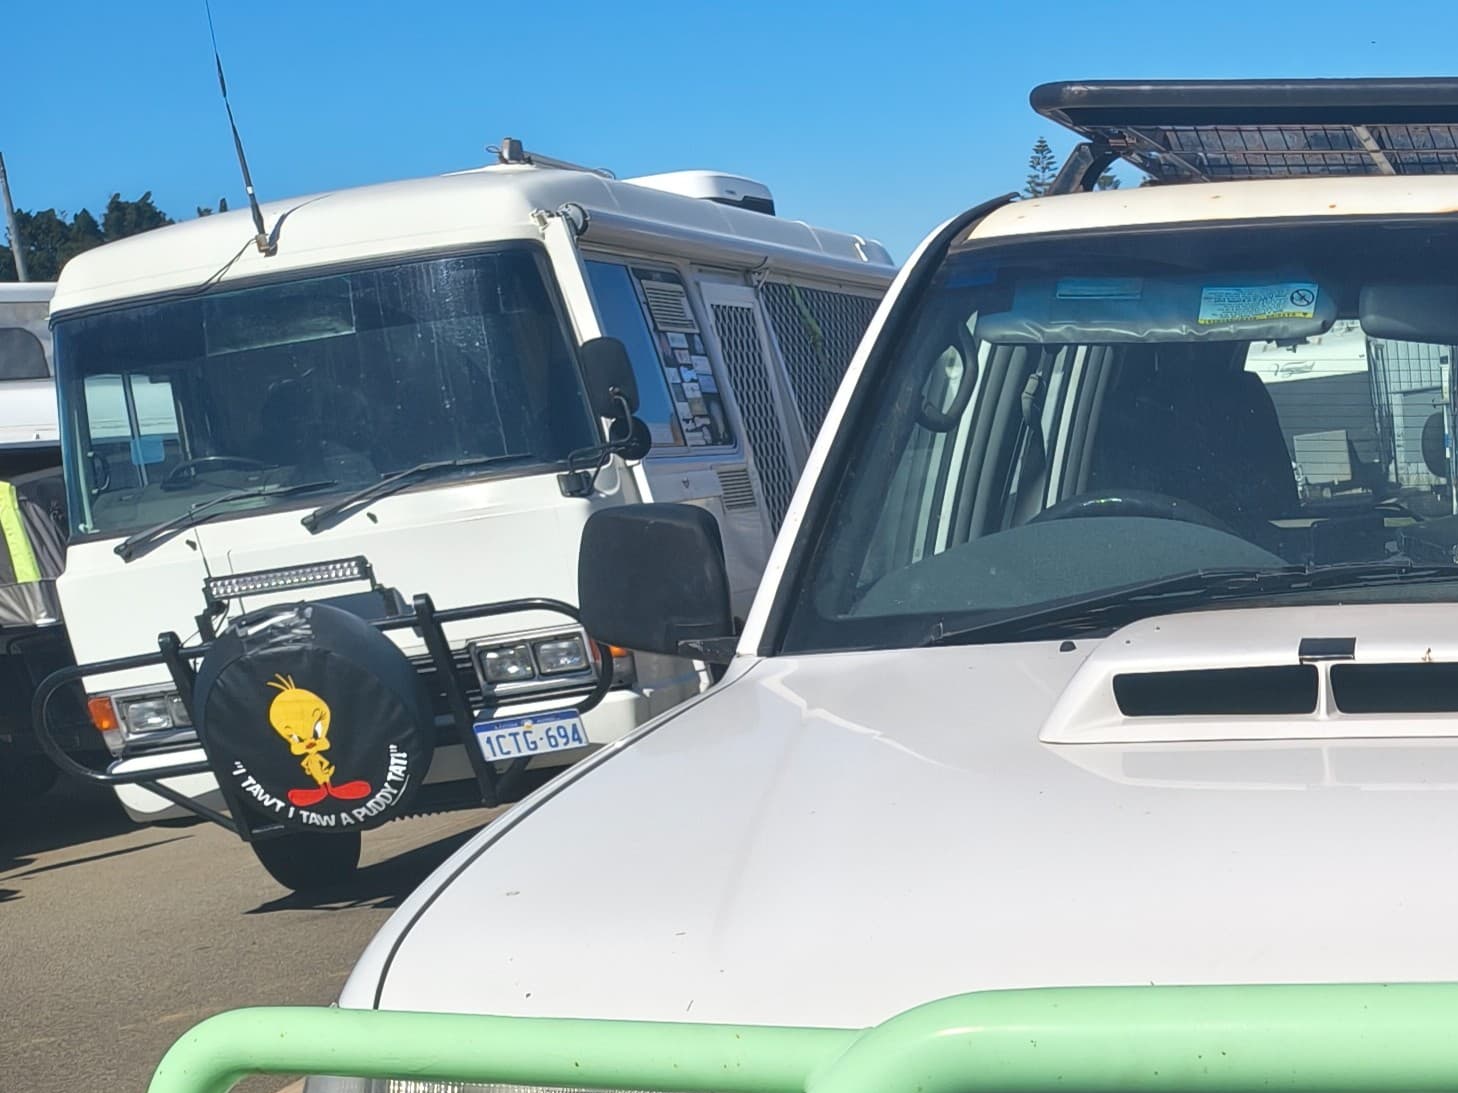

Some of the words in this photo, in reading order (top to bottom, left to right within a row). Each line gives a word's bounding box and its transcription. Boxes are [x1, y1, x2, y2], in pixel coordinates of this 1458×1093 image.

[241, 775, 286, 812] TAWT
[288, 806, 295, 819] I
[299, 810, 336, 827] TAW
[341, 814, 354, 826] A
[353, 782, 398, 822] PUDDY
